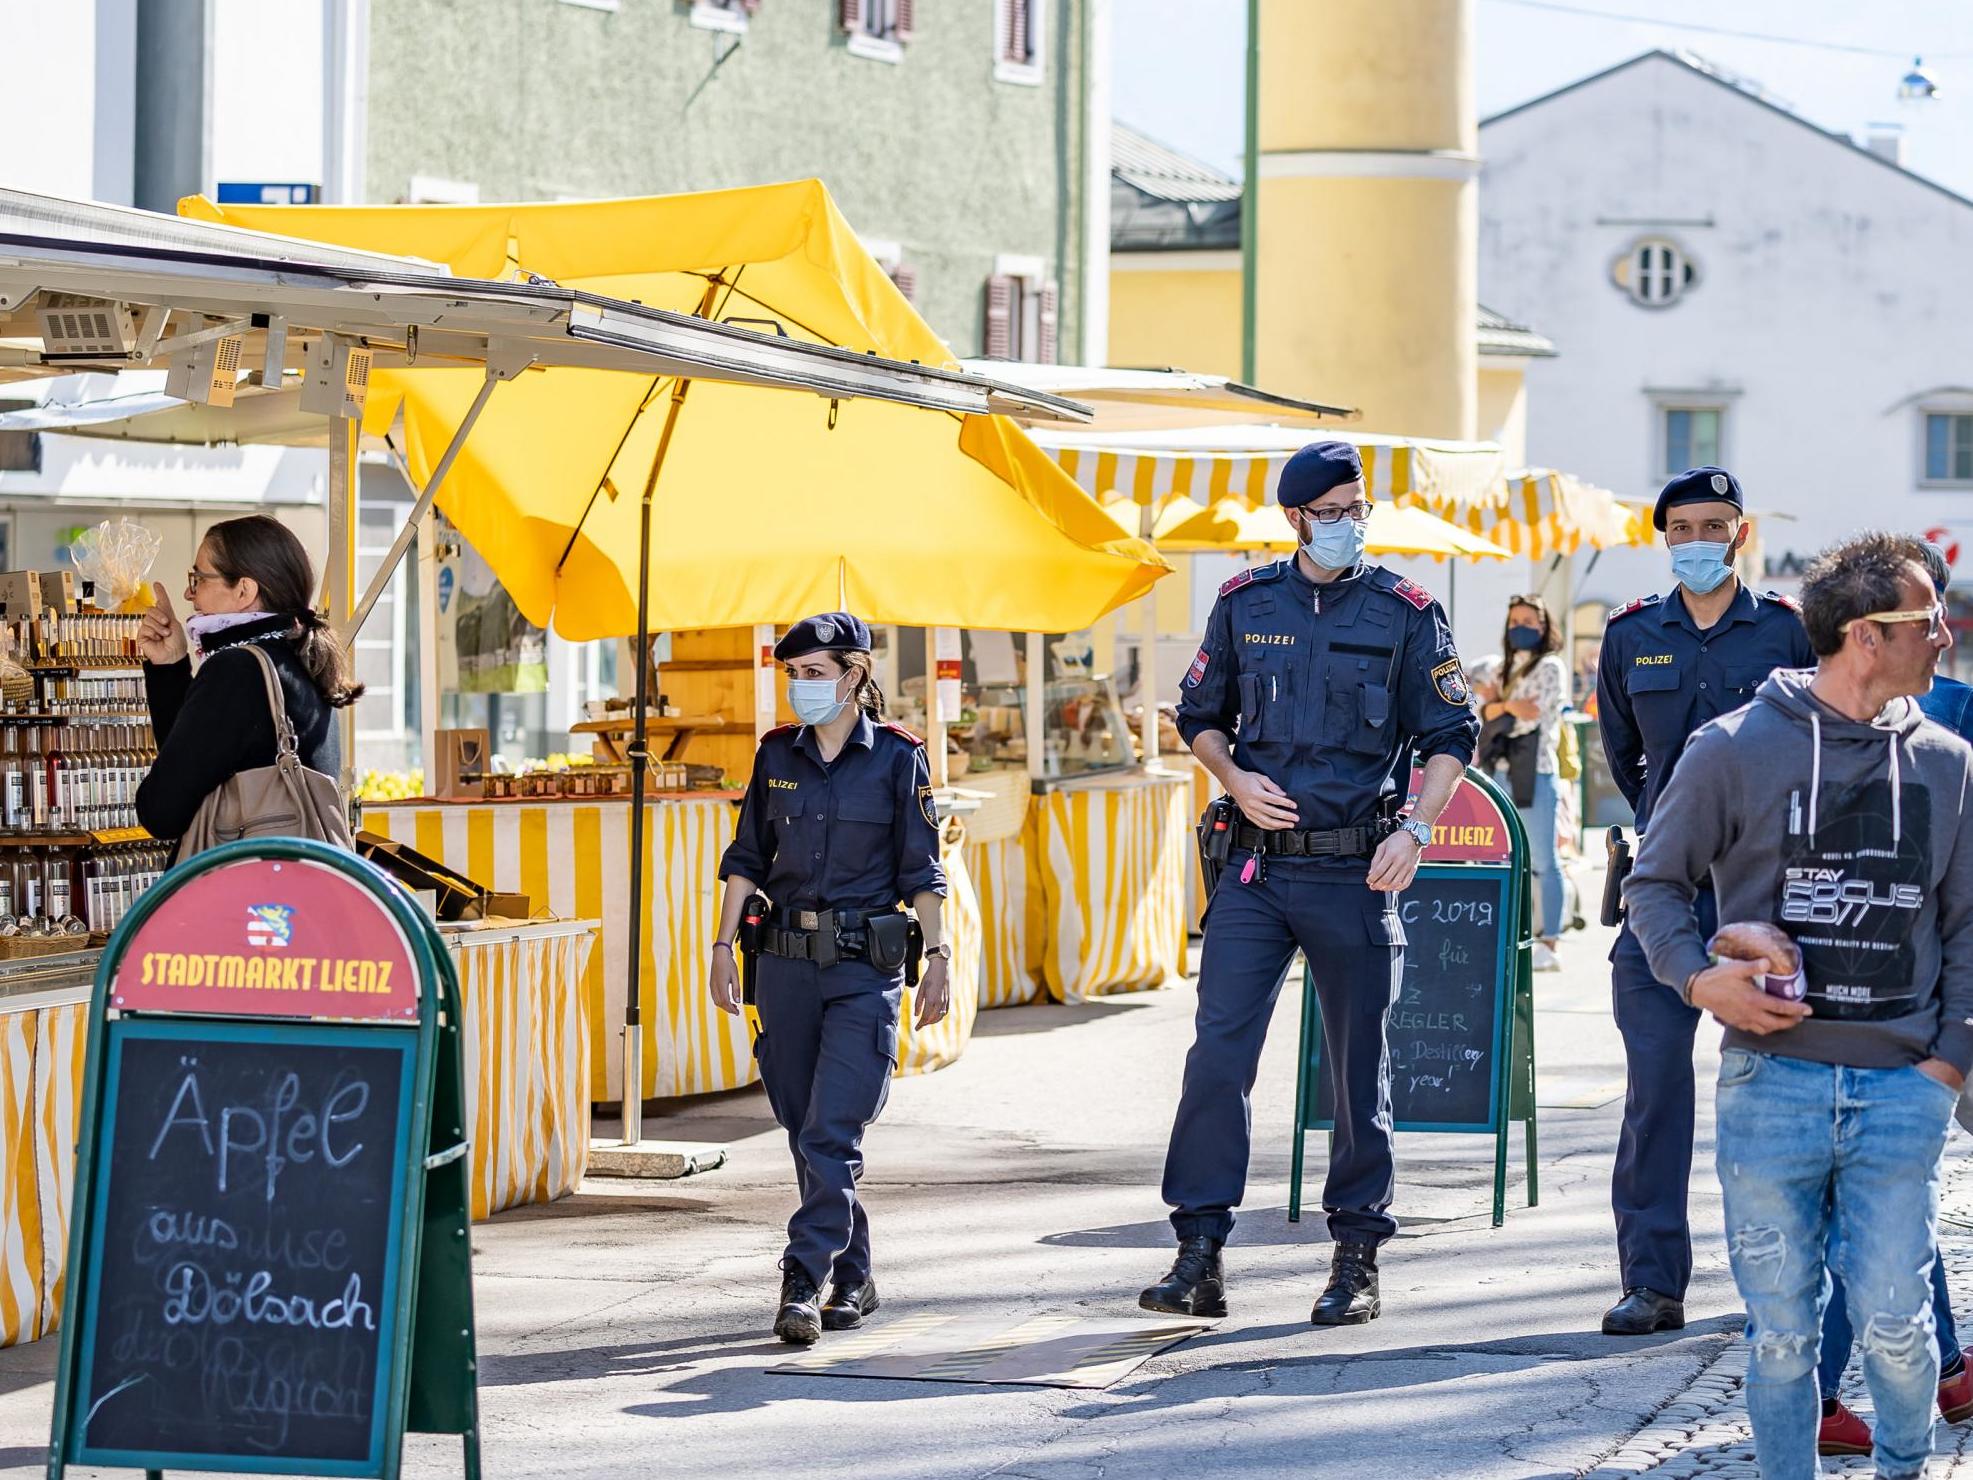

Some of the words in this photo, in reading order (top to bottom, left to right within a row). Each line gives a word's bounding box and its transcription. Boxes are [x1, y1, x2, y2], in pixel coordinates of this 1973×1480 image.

[1244, 633, 1295, 646] POLIZEI
[1635, 654, 1673, 667] POLIZEI
[1449, 825, 1495, 847] LIENZ
[1785, 867, 1845, 882] STAY
[1431, 899, 1493, 926] 2019
[1438, 937, 1470, 972] für
[140, 952, 317, 991] STADTMARKT
[319, 959, 393, 994] LIENZ
[149, 1055, 370, 1201] Äpfel
[150, 1210, 238, 1250] aus
[163, 1260, 376, 1331] Dölsach
